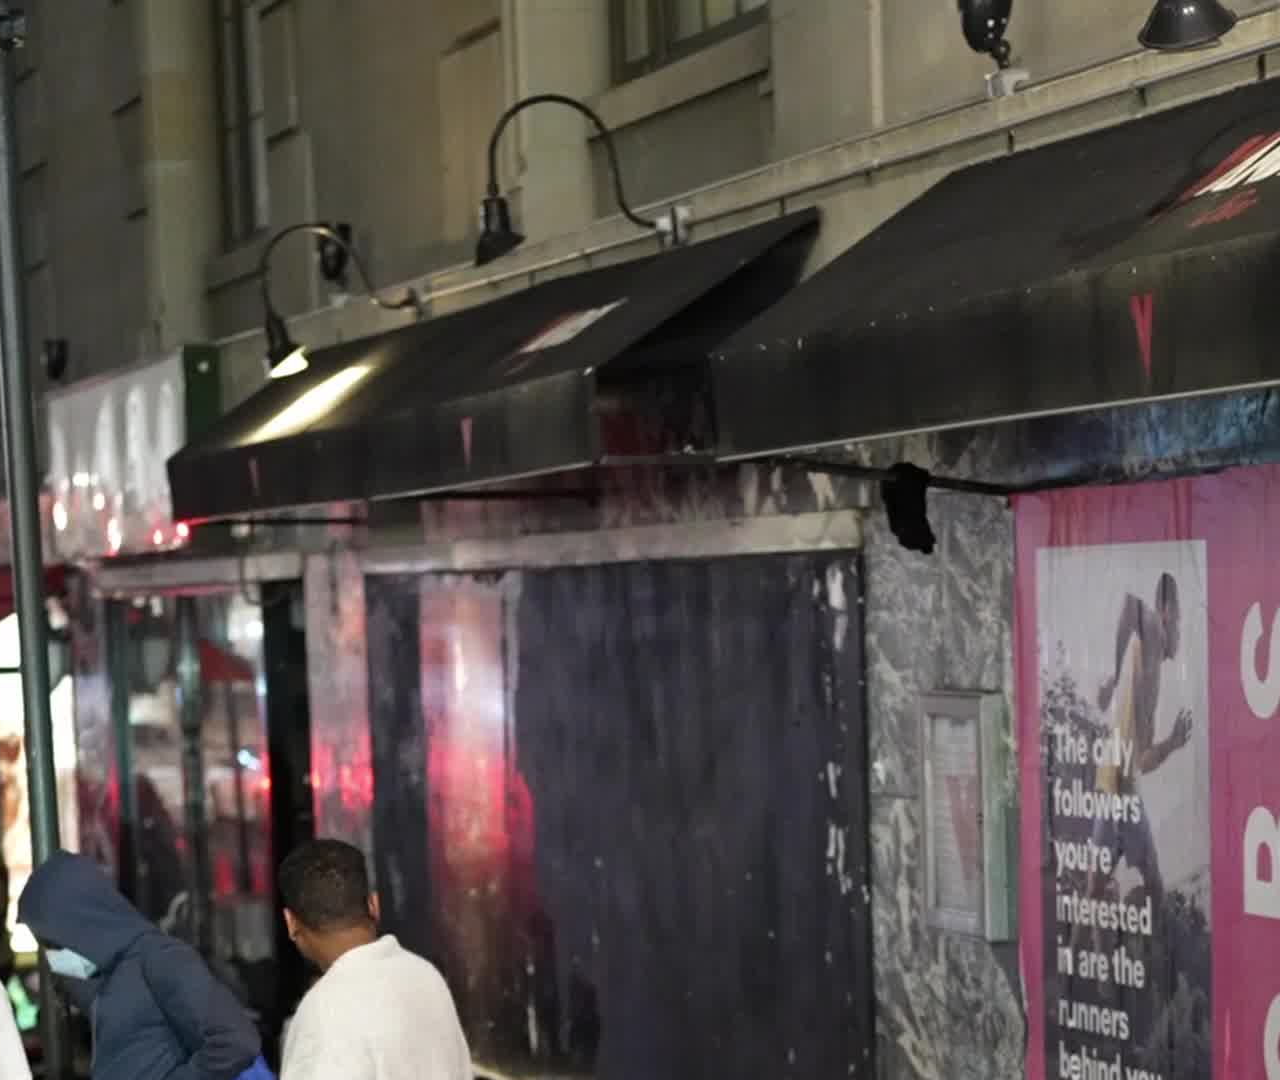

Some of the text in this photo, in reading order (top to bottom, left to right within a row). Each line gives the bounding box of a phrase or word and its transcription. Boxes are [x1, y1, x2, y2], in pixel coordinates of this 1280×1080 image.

[1052, 723, 1133, 777] The only
[1053, 778, 1141, 824] followers
[1054, 838, 1112, 878] you're
[1055, 883, 1152, 935] interested
[1056, 935, 1145, 988] in are the
[1057, 999, 1130, 1040] runners
